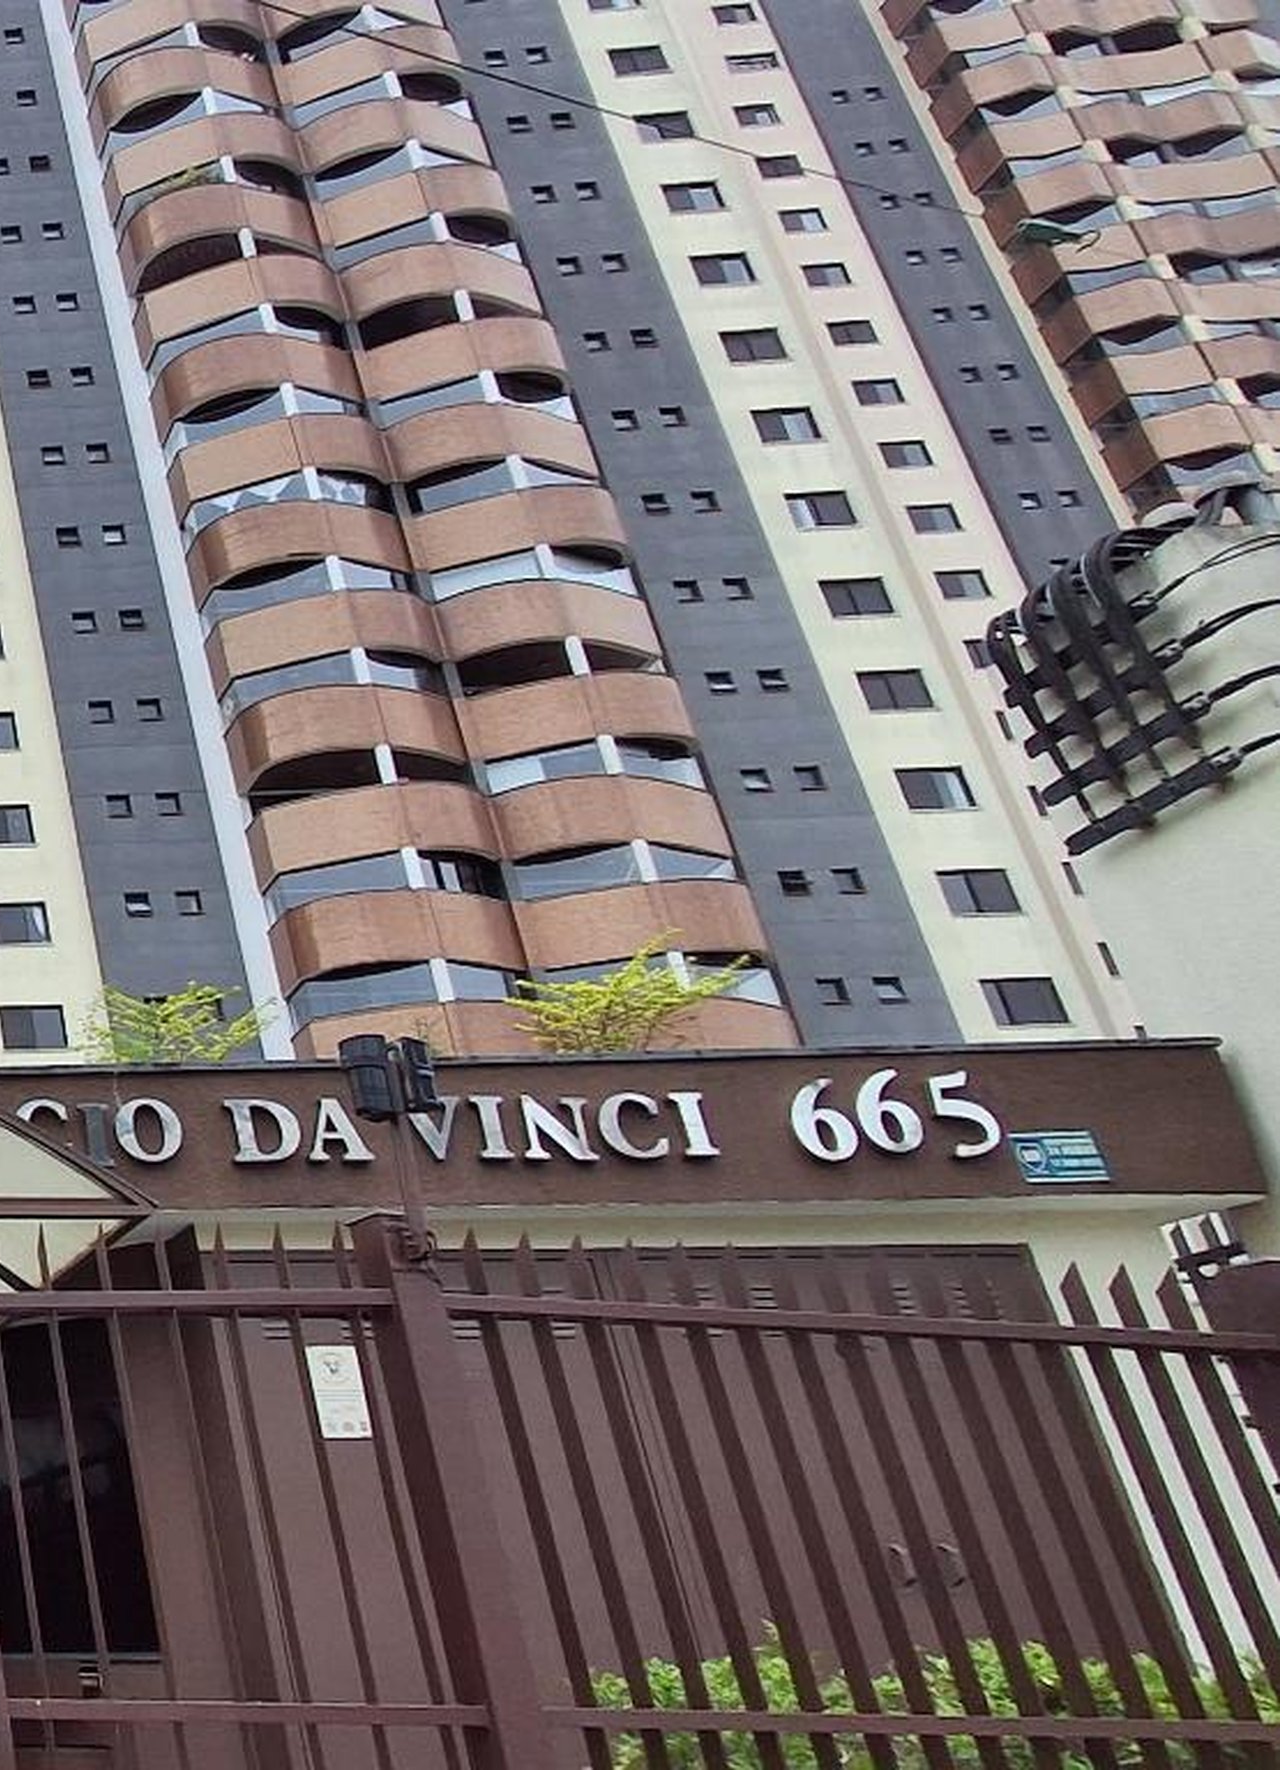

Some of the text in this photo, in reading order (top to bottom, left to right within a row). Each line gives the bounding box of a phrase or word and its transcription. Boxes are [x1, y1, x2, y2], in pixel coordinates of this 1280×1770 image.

[224, 1098, 375, 1162] DA
[406, 1092, 721, 1160] VINCI
[790, 1069, 1001, 1162] 665
